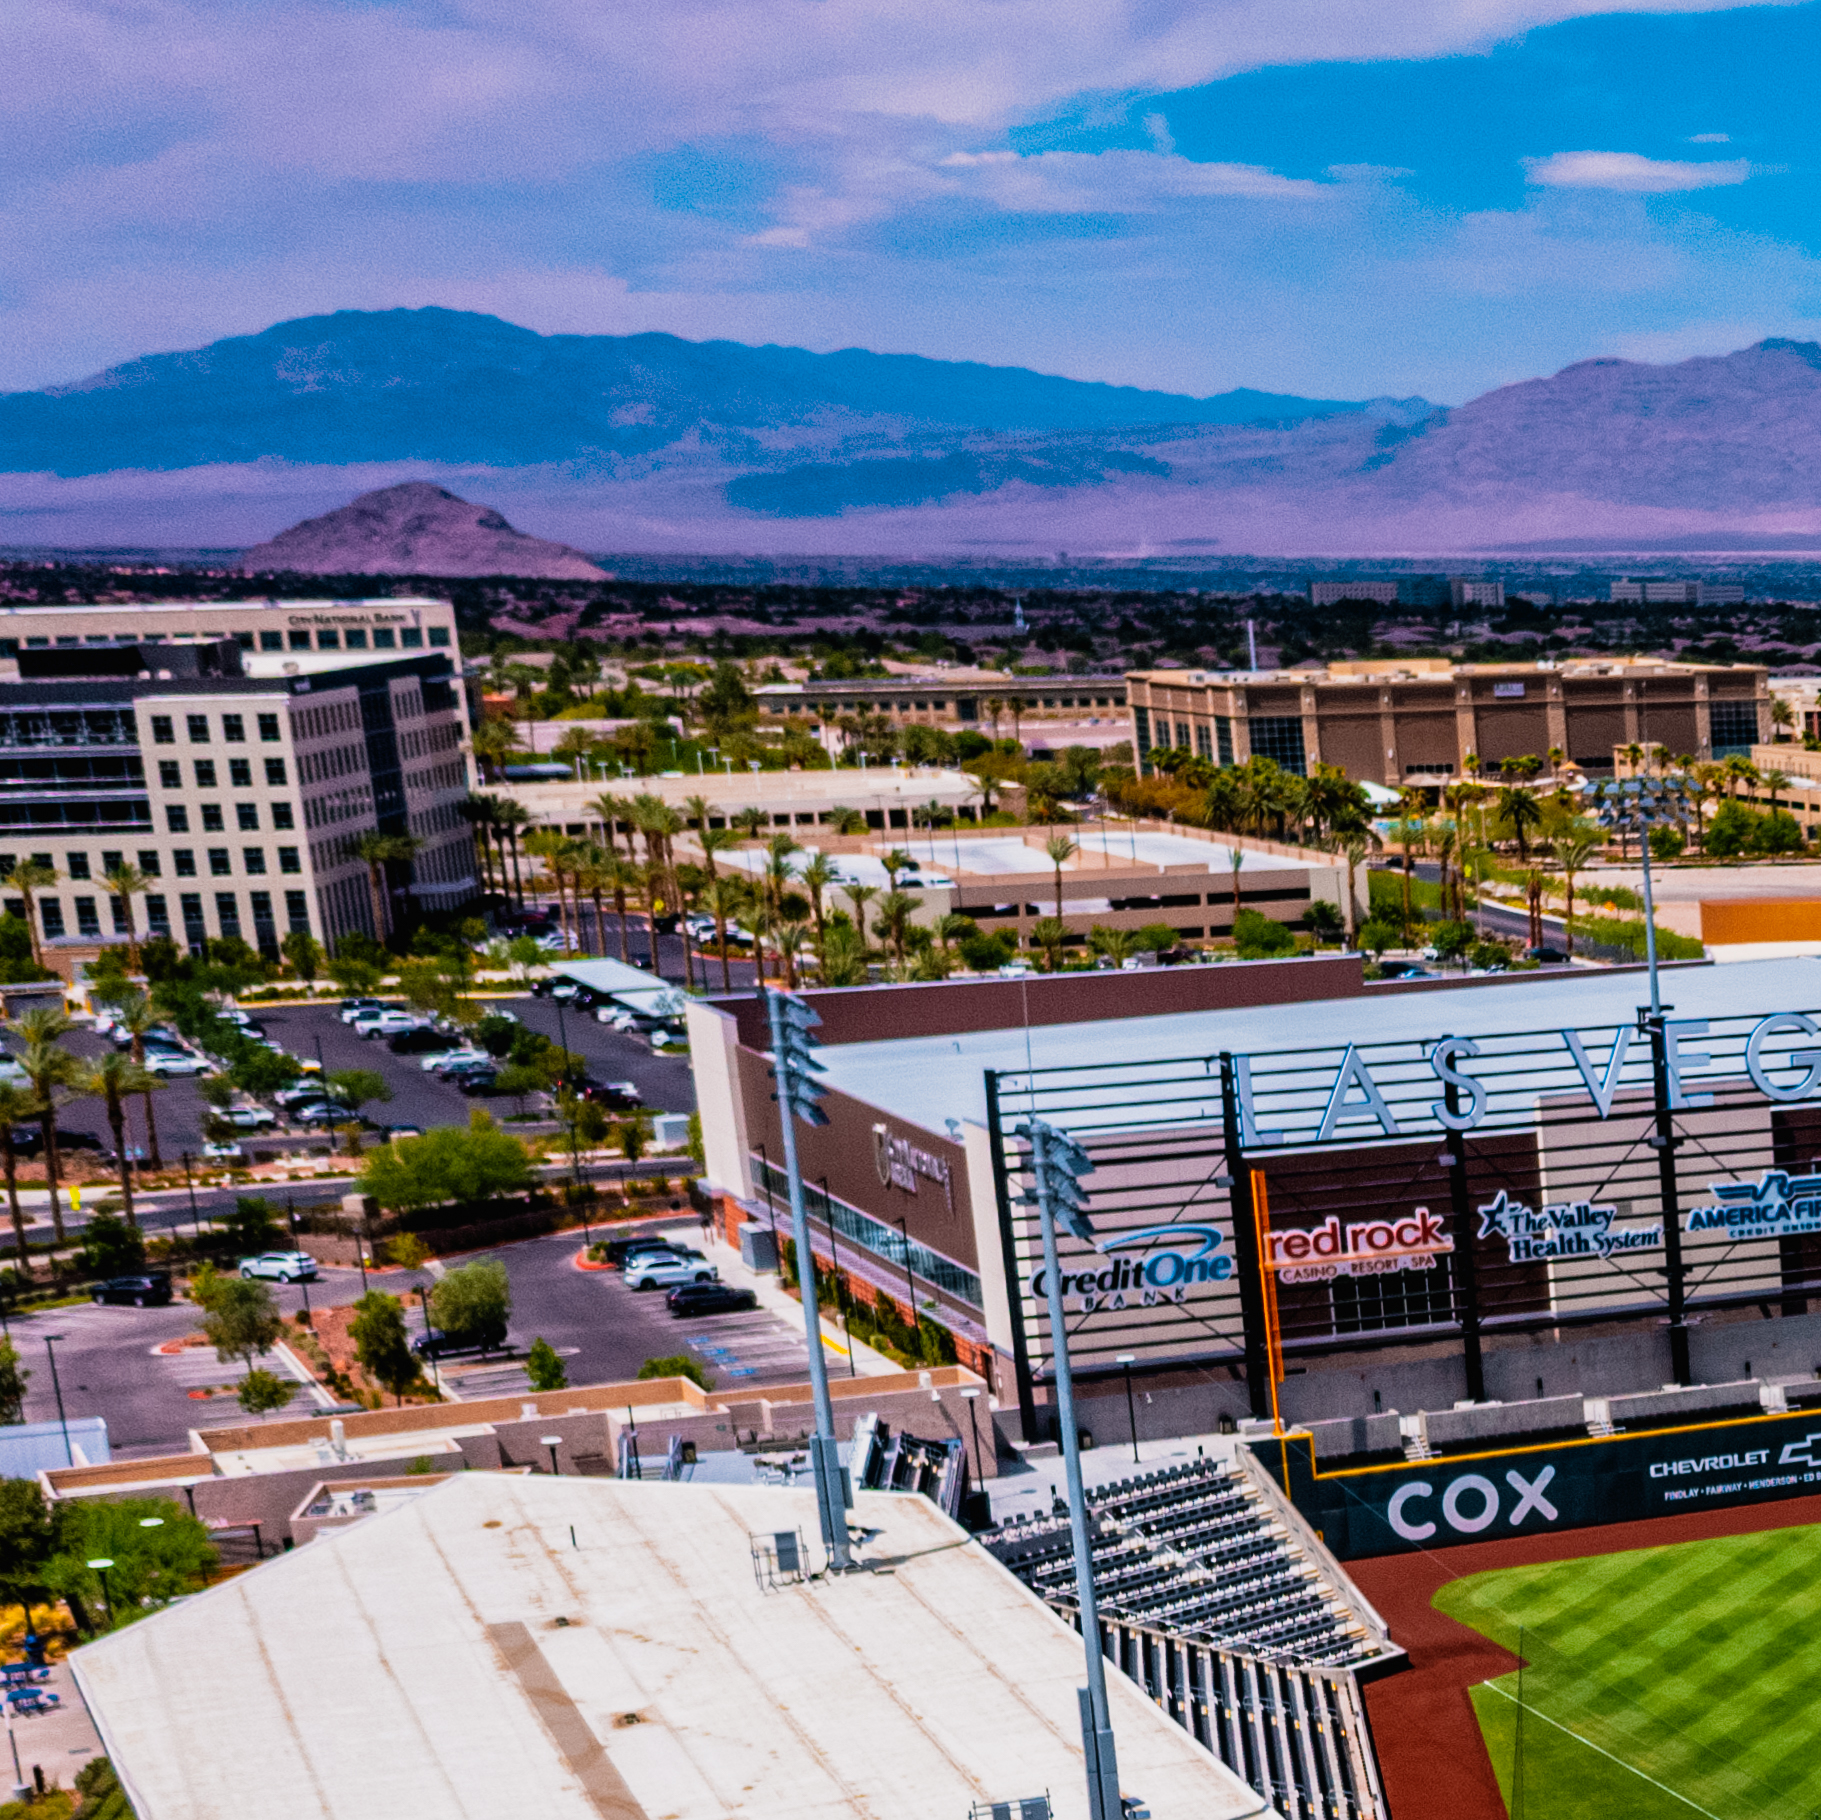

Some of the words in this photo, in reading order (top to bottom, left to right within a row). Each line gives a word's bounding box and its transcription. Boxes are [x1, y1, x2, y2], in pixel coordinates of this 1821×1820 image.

[1235, 1037, 1487, 1147] LAS
[1690, 1203, 1790, 1230] AMERICA
[1730, 1226, 1775, 1238] CREDIT
[1783, 1222, 1821, 1232] UNION
[1271, 1222, 1339, 1260] red
[1351, 1213, 1444, 1251] rock
[1283, 1265, 1337, 1281] CASINO
[1352, 1259, 1399, 1273] RESORT
[1411, 1255, 1433, 1268] SPA
[1086, 1287, 1184, 1308] BANK
[1649, 1449, 1770, 1478] CHEVROLET
[1706, 1482, 1742, 1496] FAIRWAY
[1749, 1475, 1798, 1490] HENDERSON
[1804, 1472, 1815, 1482] ED
[1388, 1465, 1558, 1541] COX
